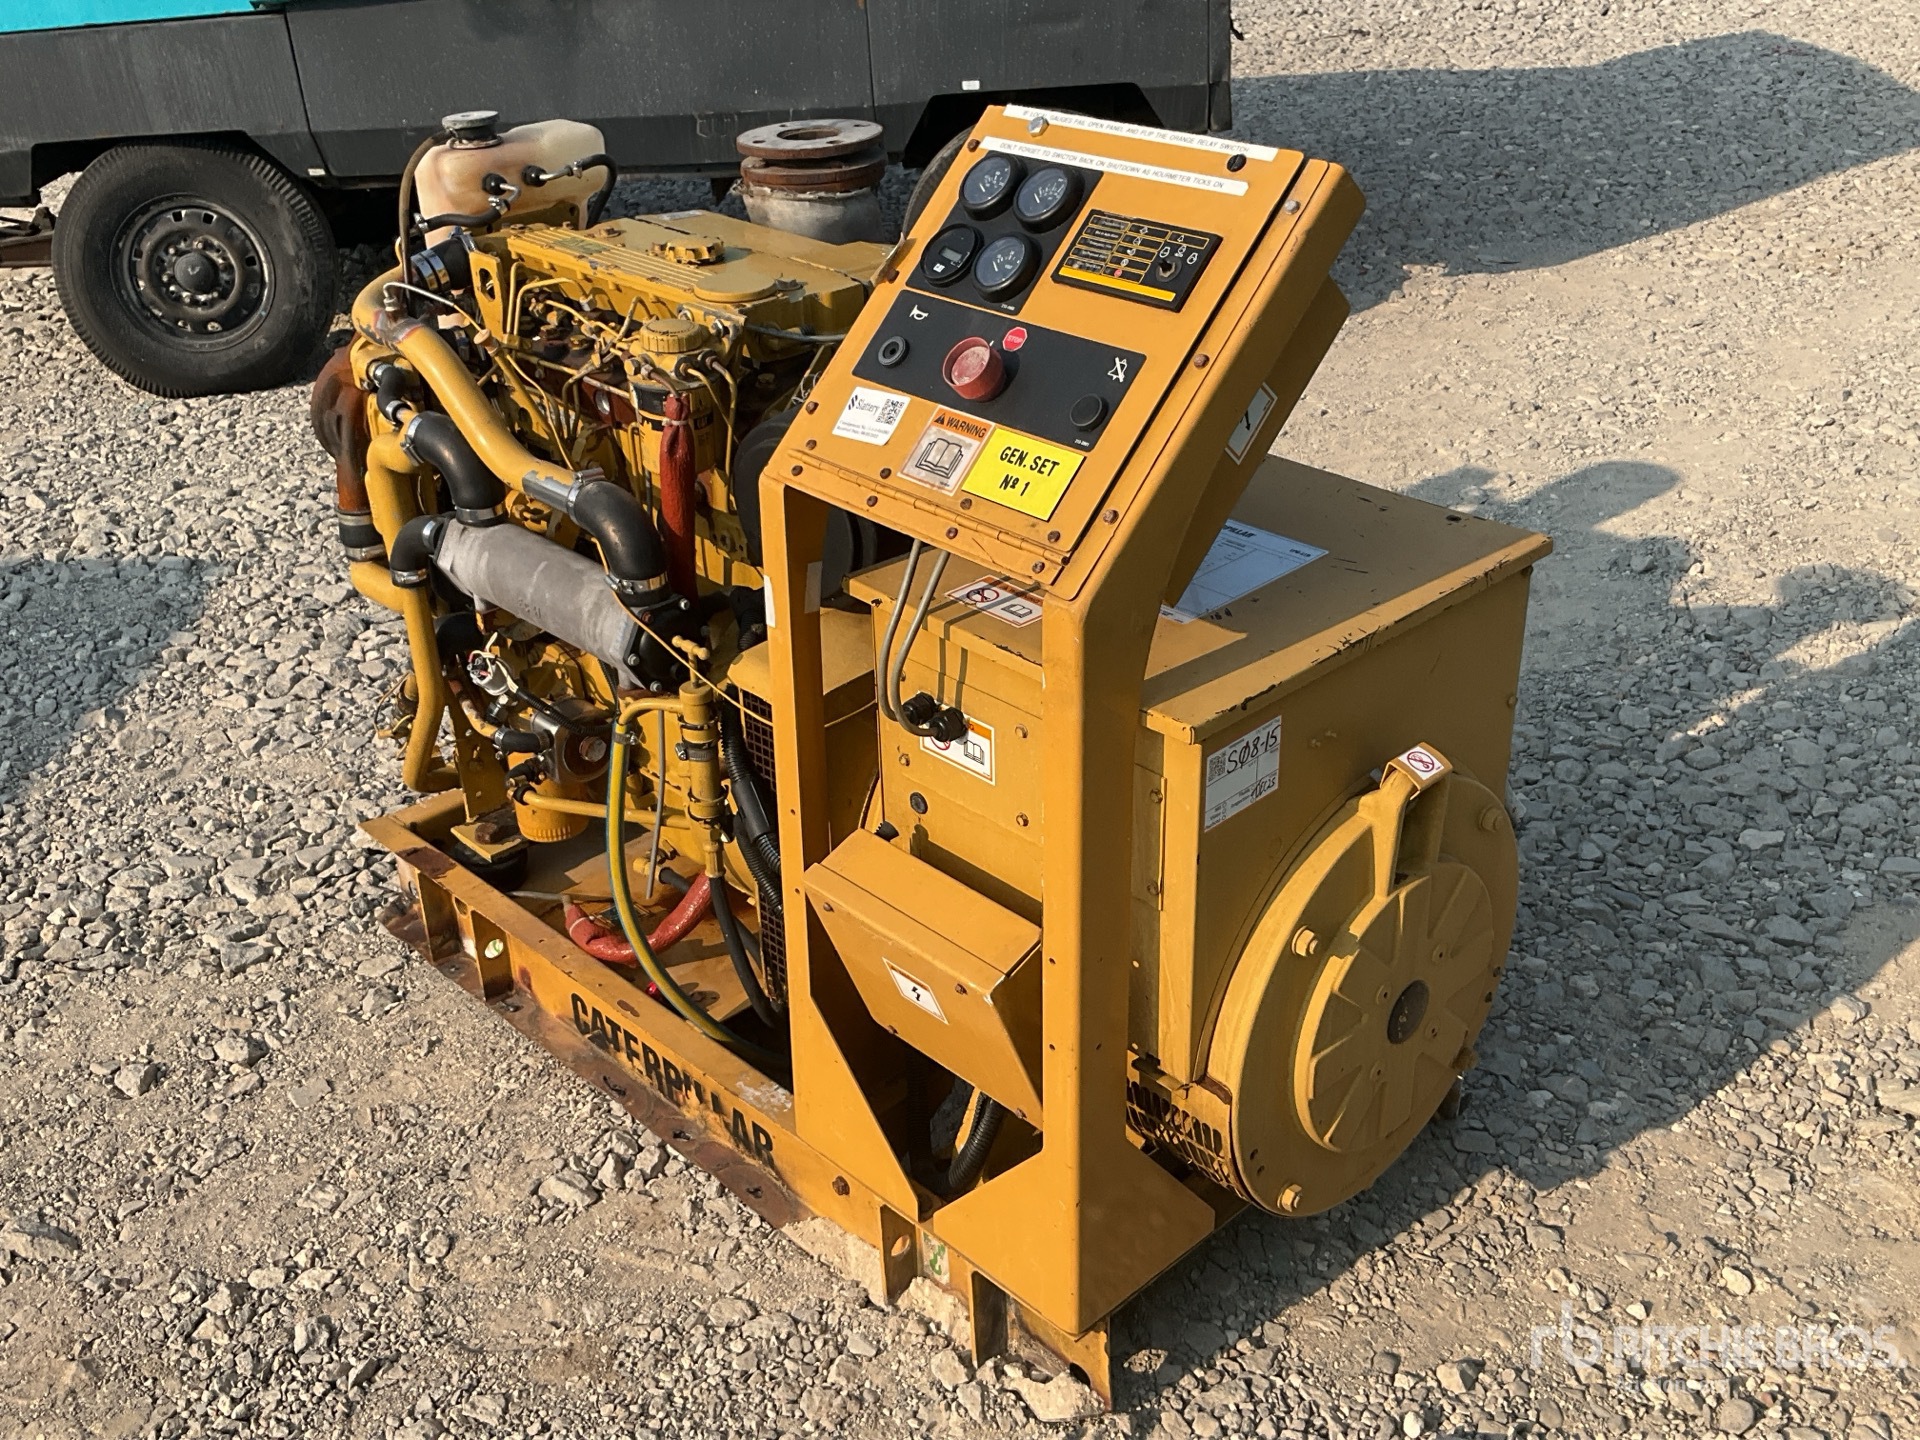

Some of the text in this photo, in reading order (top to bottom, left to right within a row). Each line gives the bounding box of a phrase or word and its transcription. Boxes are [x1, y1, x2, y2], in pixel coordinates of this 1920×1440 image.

[1049, 114, 1073, 124] GAUGES
[1073, 118, 1086, 127] FAIL
[1088, 121, 1105, 129] OPEN
[1105, 123, 1124, 133] PANEL
[1126, 127, 1139, 135] AND
[1140, 129, 1154, 138] FLIP
[1155, 131, 1168, 141] THE
[1169, 134, 1197, 145] ORANGE
[1197, 138, 1219, 148] RELAY
[1019, 145, 1042, 155] FORGET
[1042, 149, 1051, 157] TO
[1079, 155, 1095, 165] BACK
[1095, 159, 1106, 167] ON
[1108, 161, 1140, 174] SHUTDOWN
[1141, 167, 1152, 176] AS
[1152, 169, 1191, 182] HOURMETER
[1193, 176, 1212, 186] TICKS
[1212, 180, 1225, 189] ON
[1005, 334, 1024, 345] STOP
[946, 416, 987, 439] WARNING
[999, 445, 1061, 477] GEN. SET
[1020, 481, 1031, 497] 1
